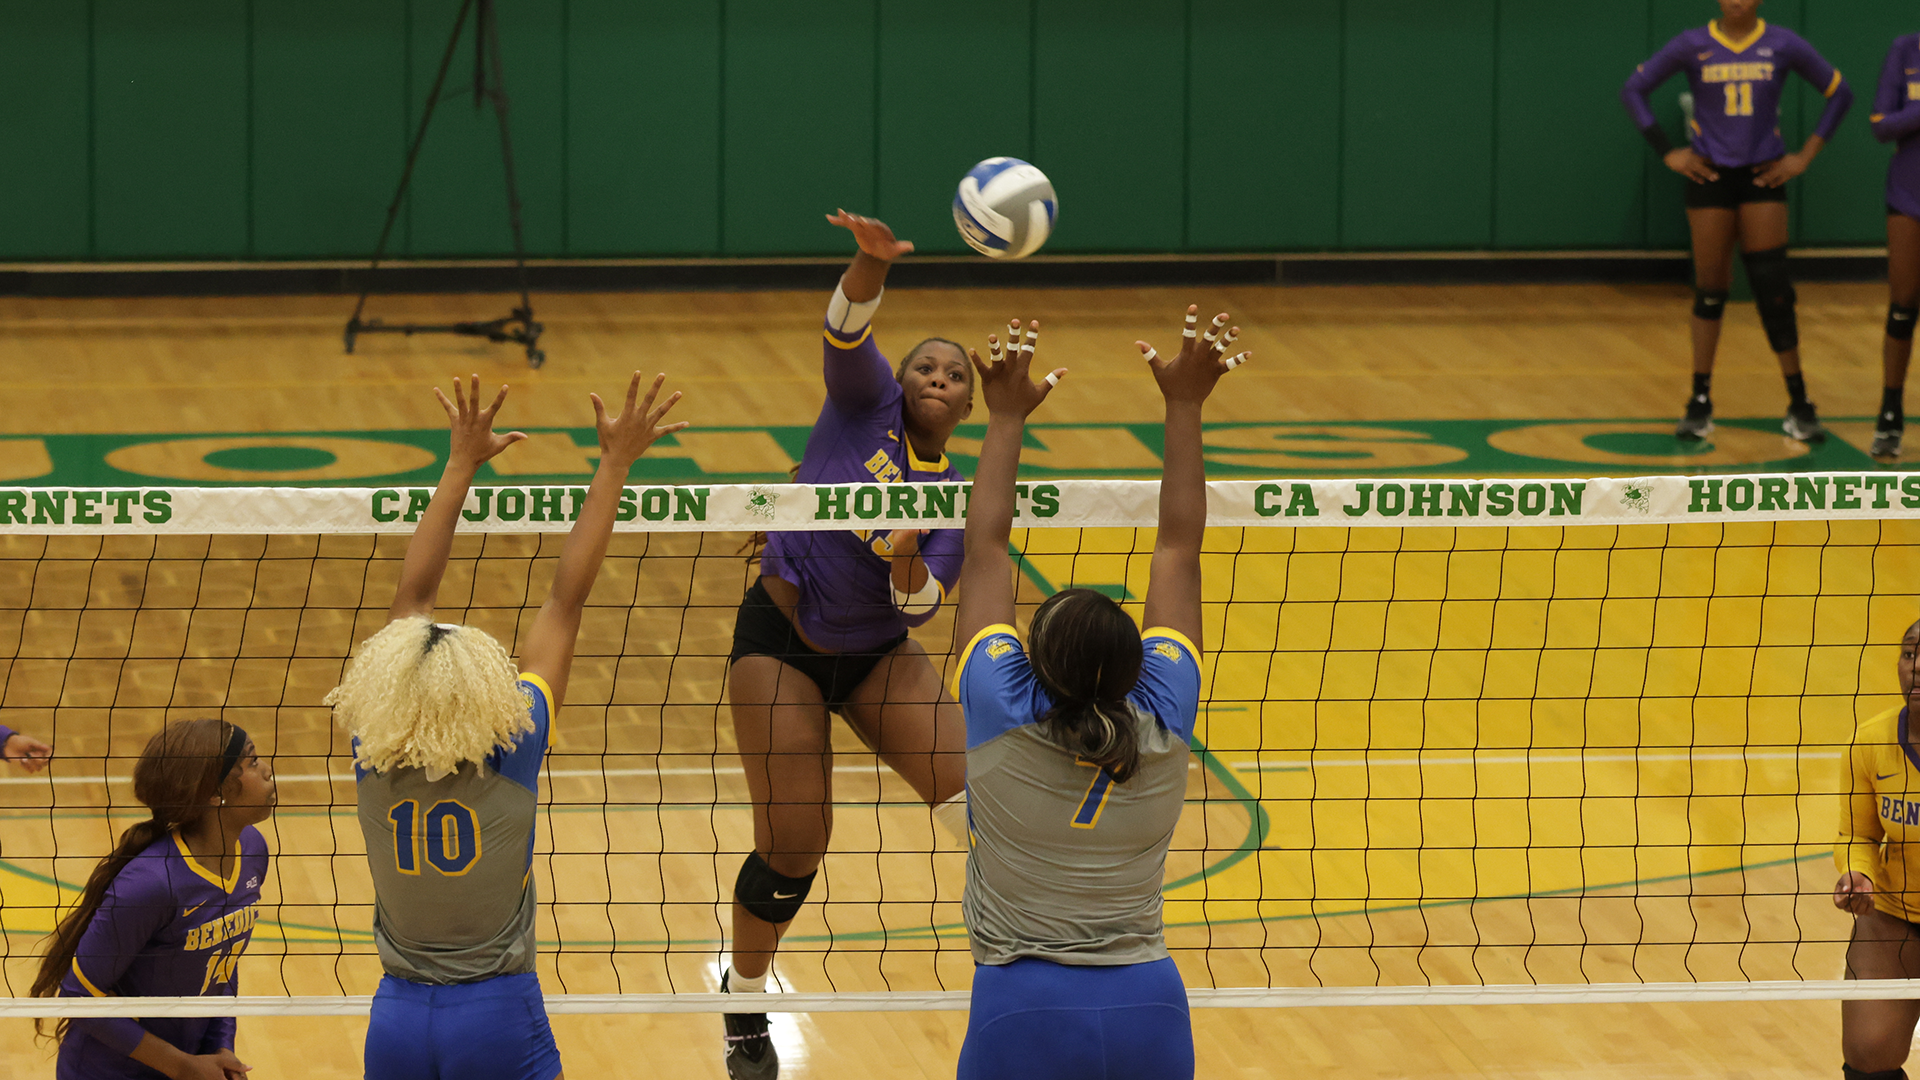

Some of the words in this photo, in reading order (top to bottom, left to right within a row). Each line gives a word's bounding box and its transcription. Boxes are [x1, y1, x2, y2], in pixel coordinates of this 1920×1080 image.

[1724, 82, 1754, 116] 11
[864, 448, 905, 482] BE
[0, 490, 172, 524] RNETS
[1254, 482, 1318, 516] CA
[1344, 481, 1585, 516] JOHNSON
[1688, 476, 1920, 512] HORNETS
[1070, 755, 1122, 829] 7
[387, 798, 482, 877] 10
[200, 938, 247, 996] 14
